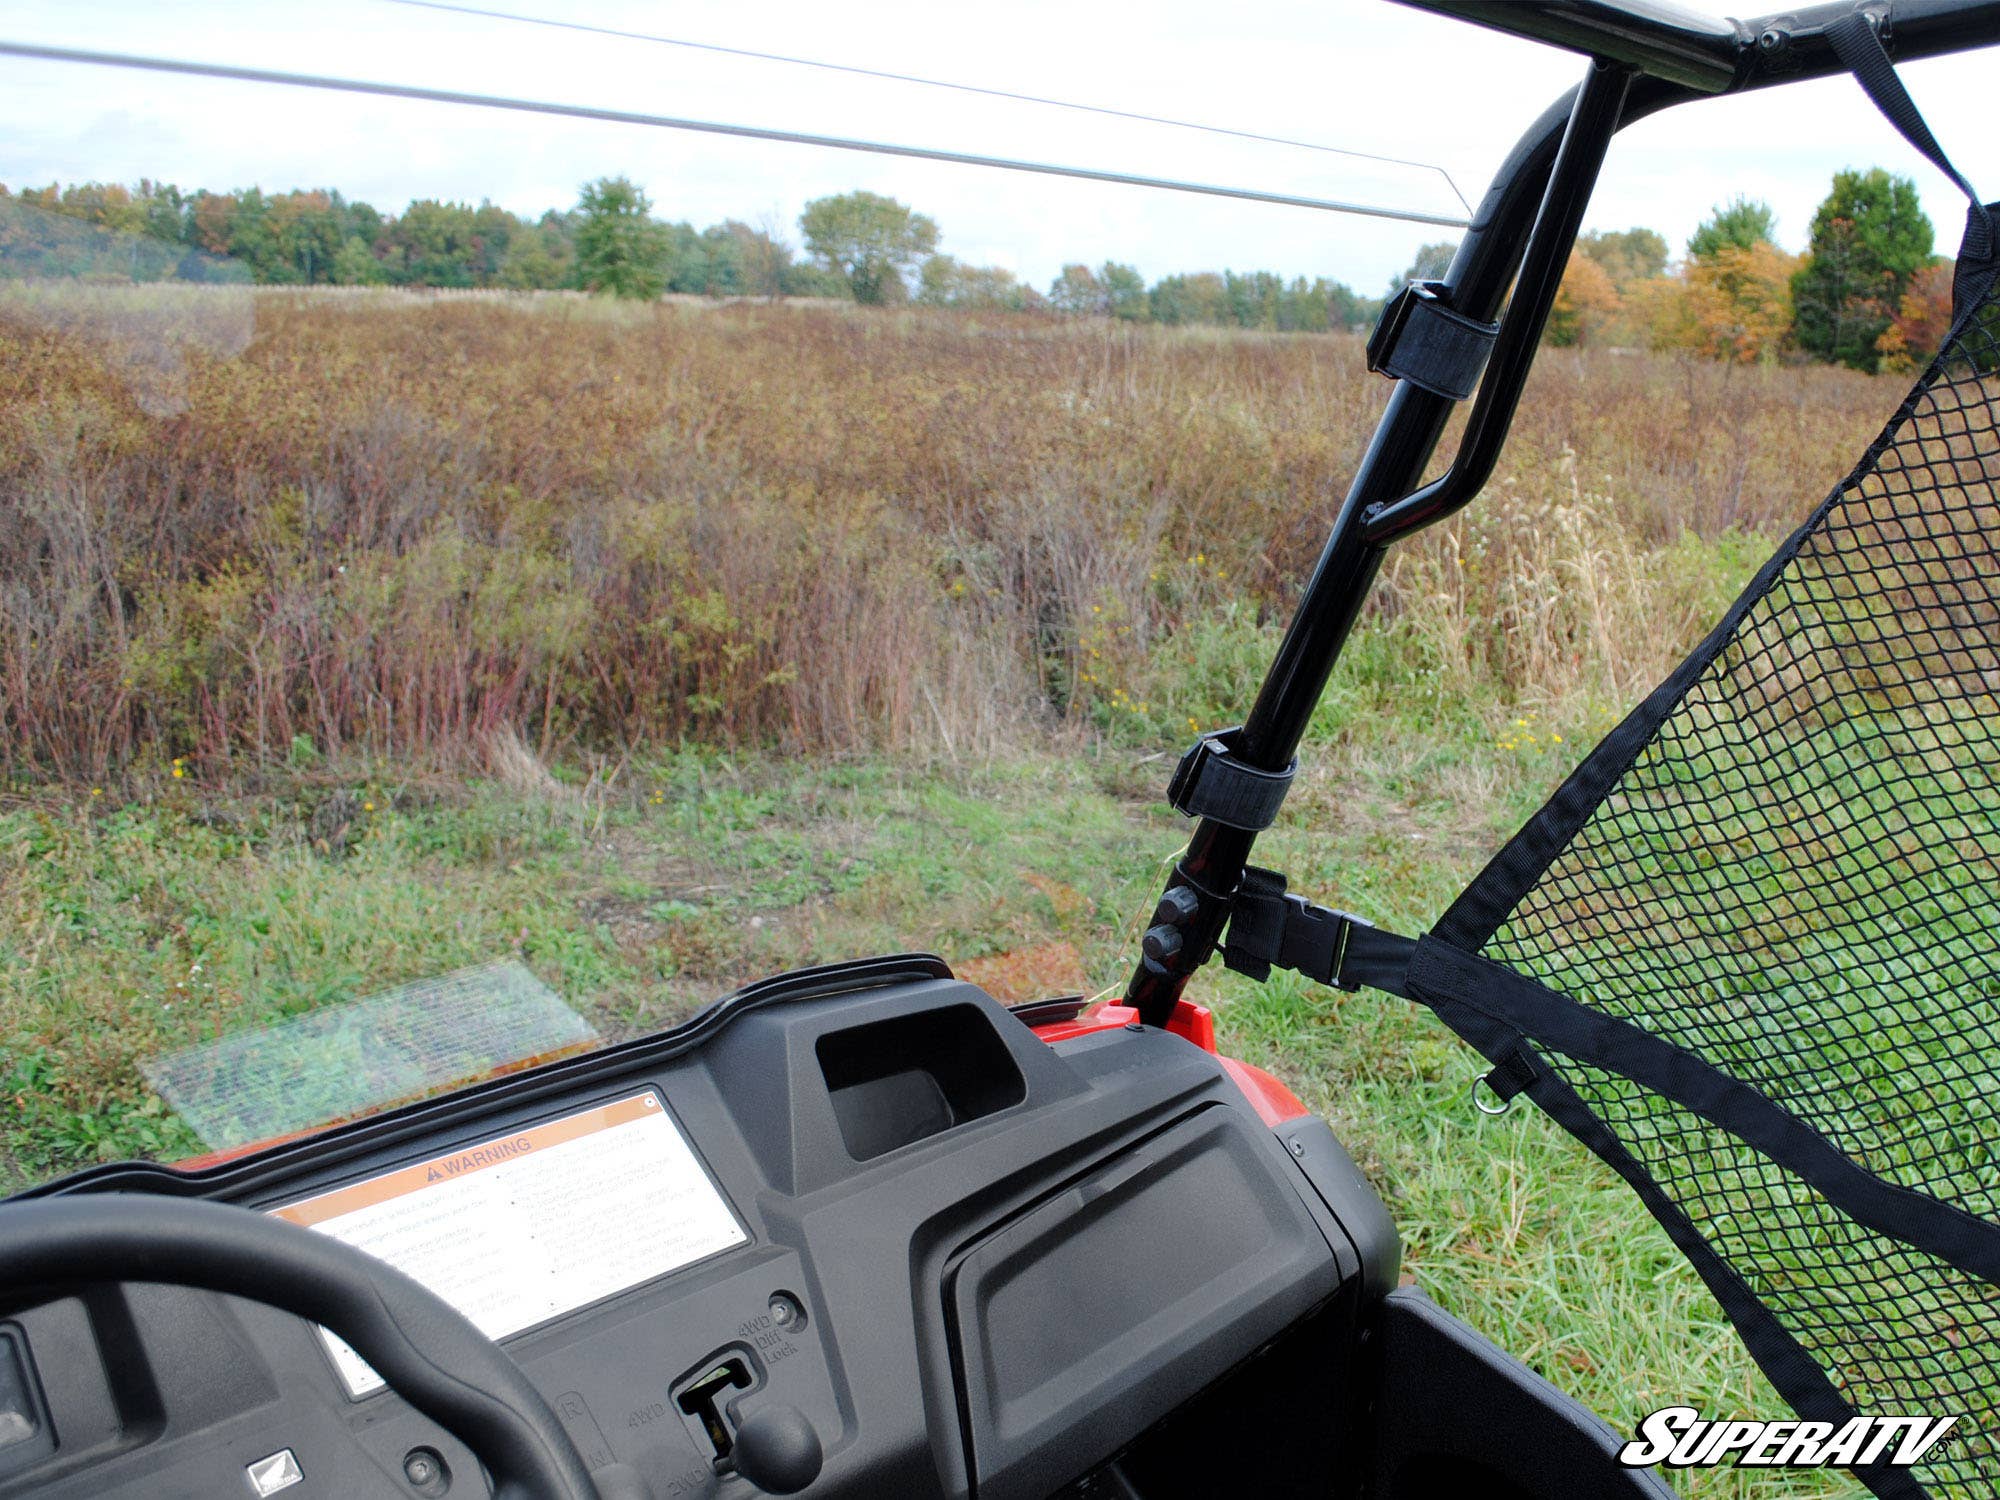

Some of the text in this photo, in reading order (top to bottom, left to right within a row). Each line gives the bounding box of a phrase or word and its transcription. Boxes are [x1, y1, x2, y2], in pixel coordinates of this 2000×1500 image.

[442, 1138, 532, 1174] WARNING
[738, 1315, 770, 1337] 4WD
[763, 1341, 799, 1364] Lock
[561, 1401, 583, 1420] R
[628, 1402, 665, 1428] 4WD
[667, 1467, 706, 1497] 2WD
